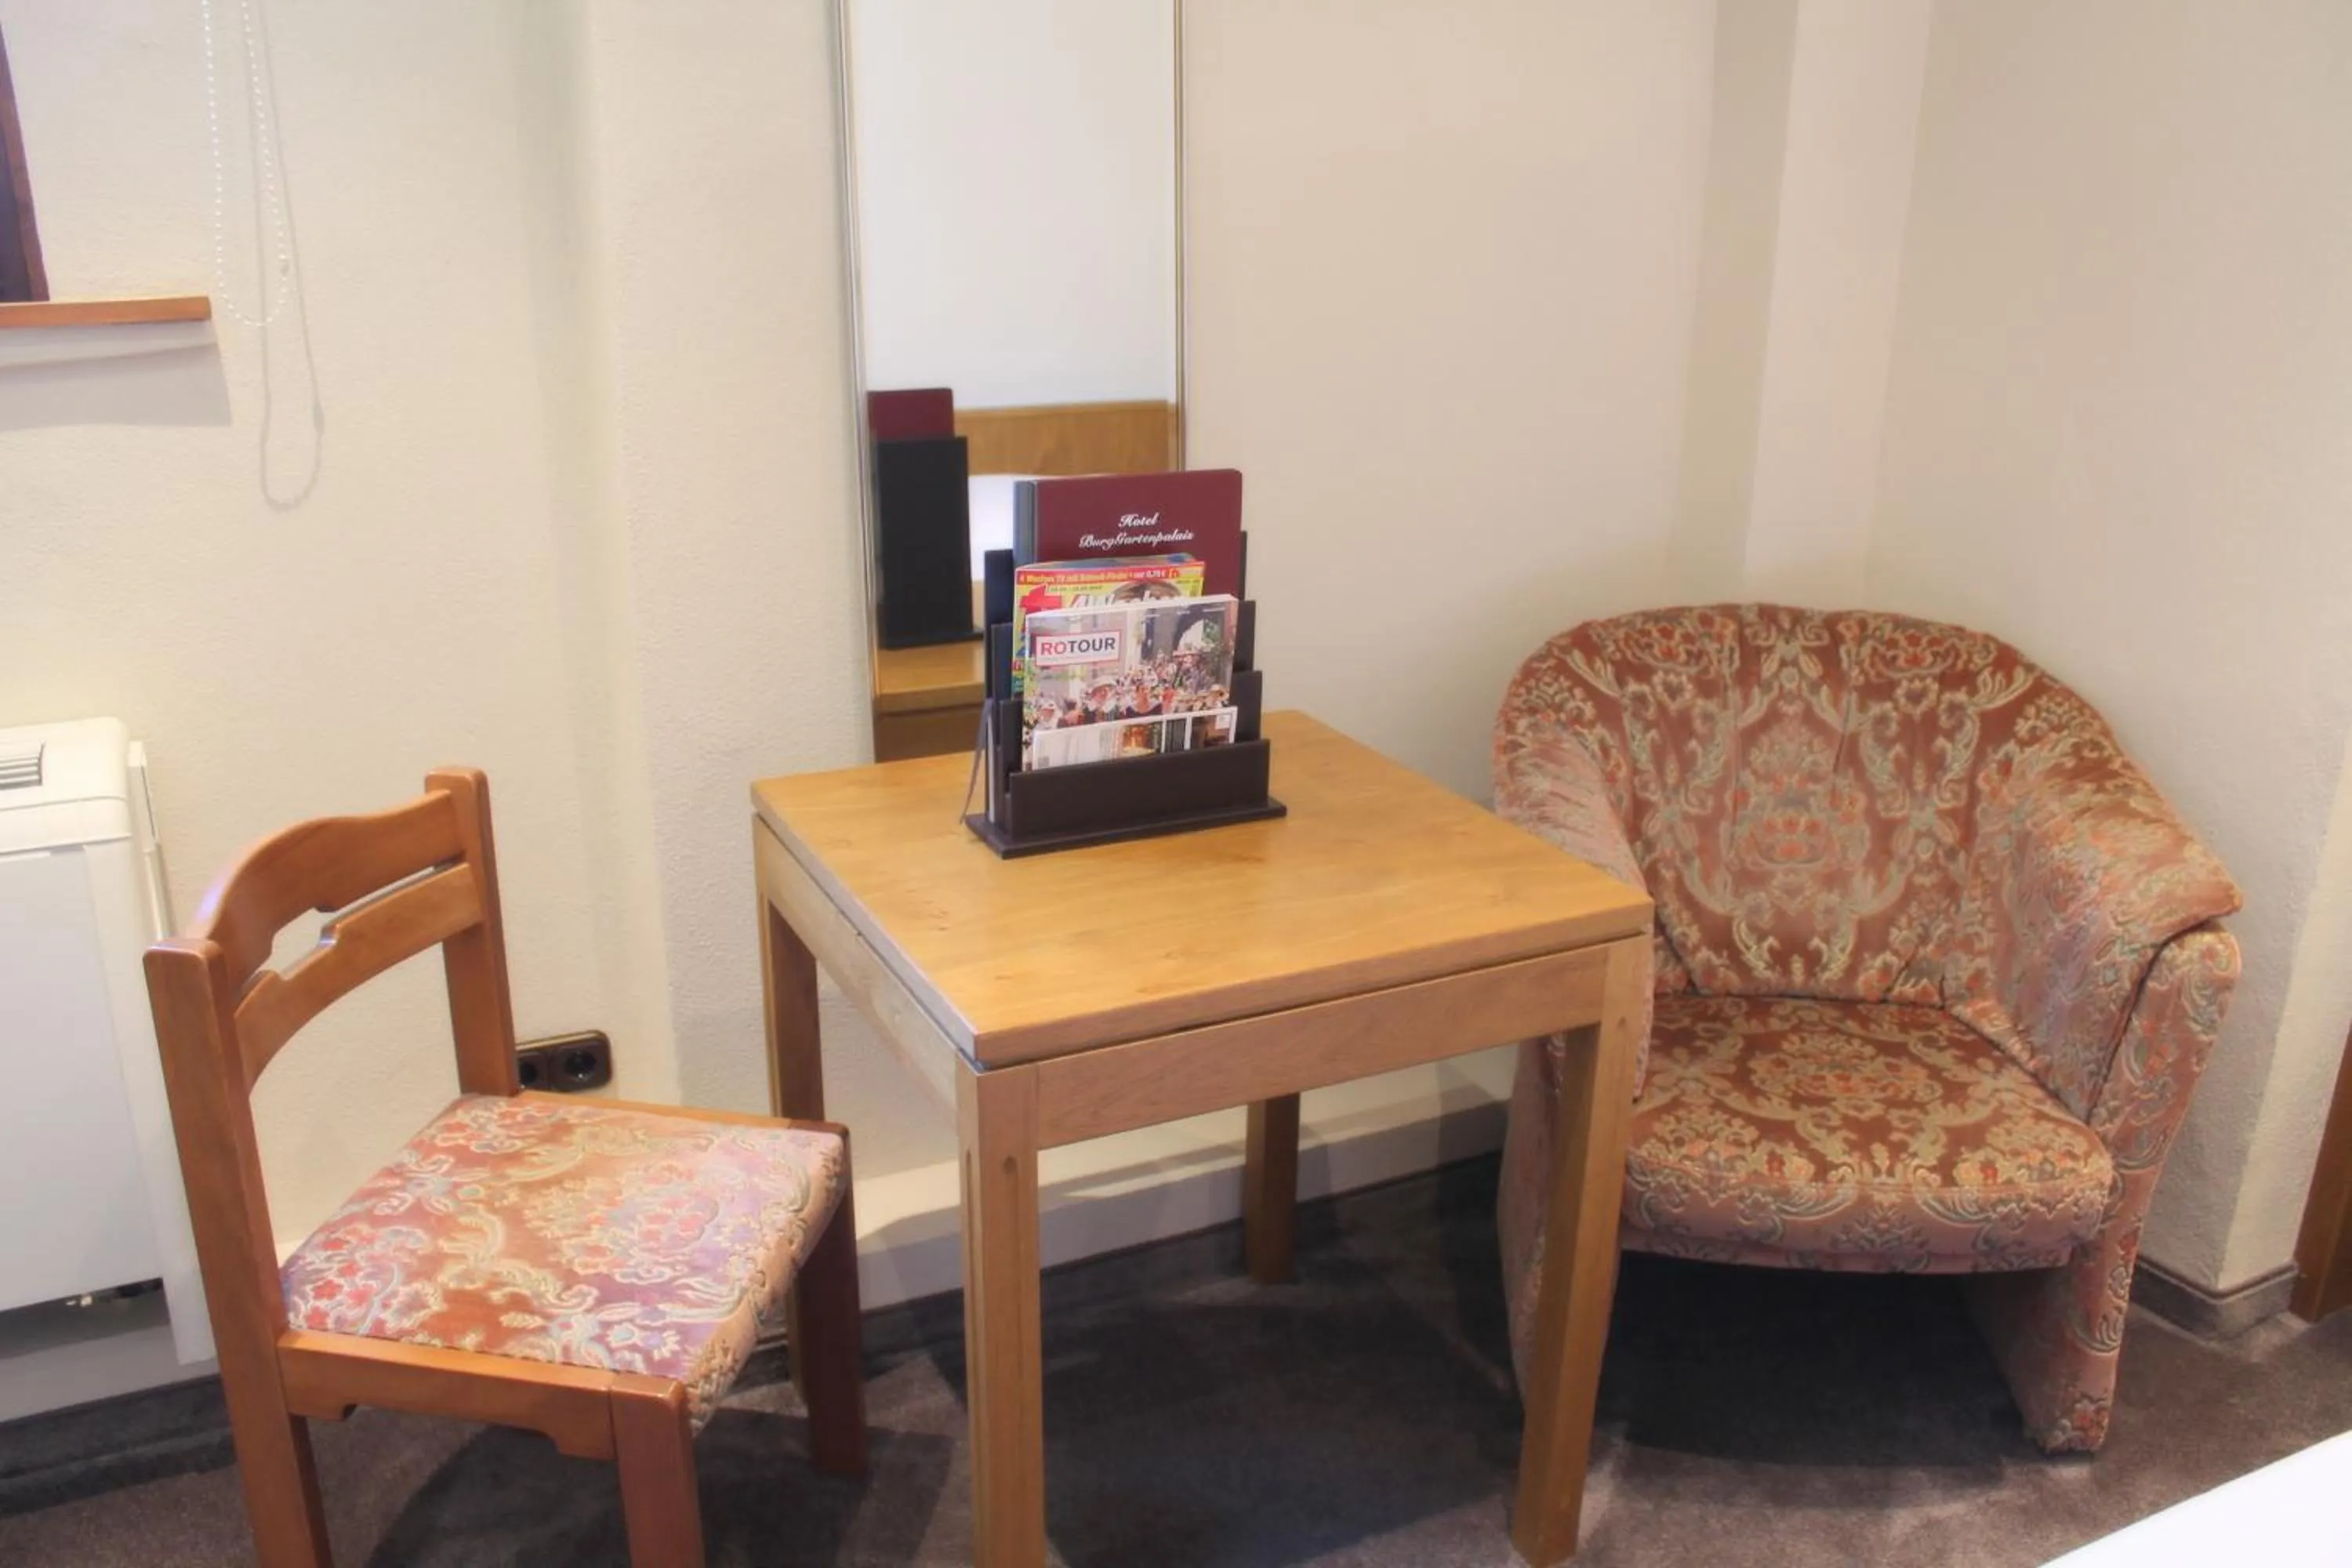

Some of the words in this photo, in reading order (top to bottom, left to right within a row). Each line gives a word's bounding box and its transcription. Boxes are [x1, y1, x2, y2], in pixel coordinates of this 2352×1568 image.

[1118, 512, 1160, 528] Hotel
[1079, 528, 1194, 550] BurgGartenpalais
[1040, 637, 1116, 655] ROTOUR
